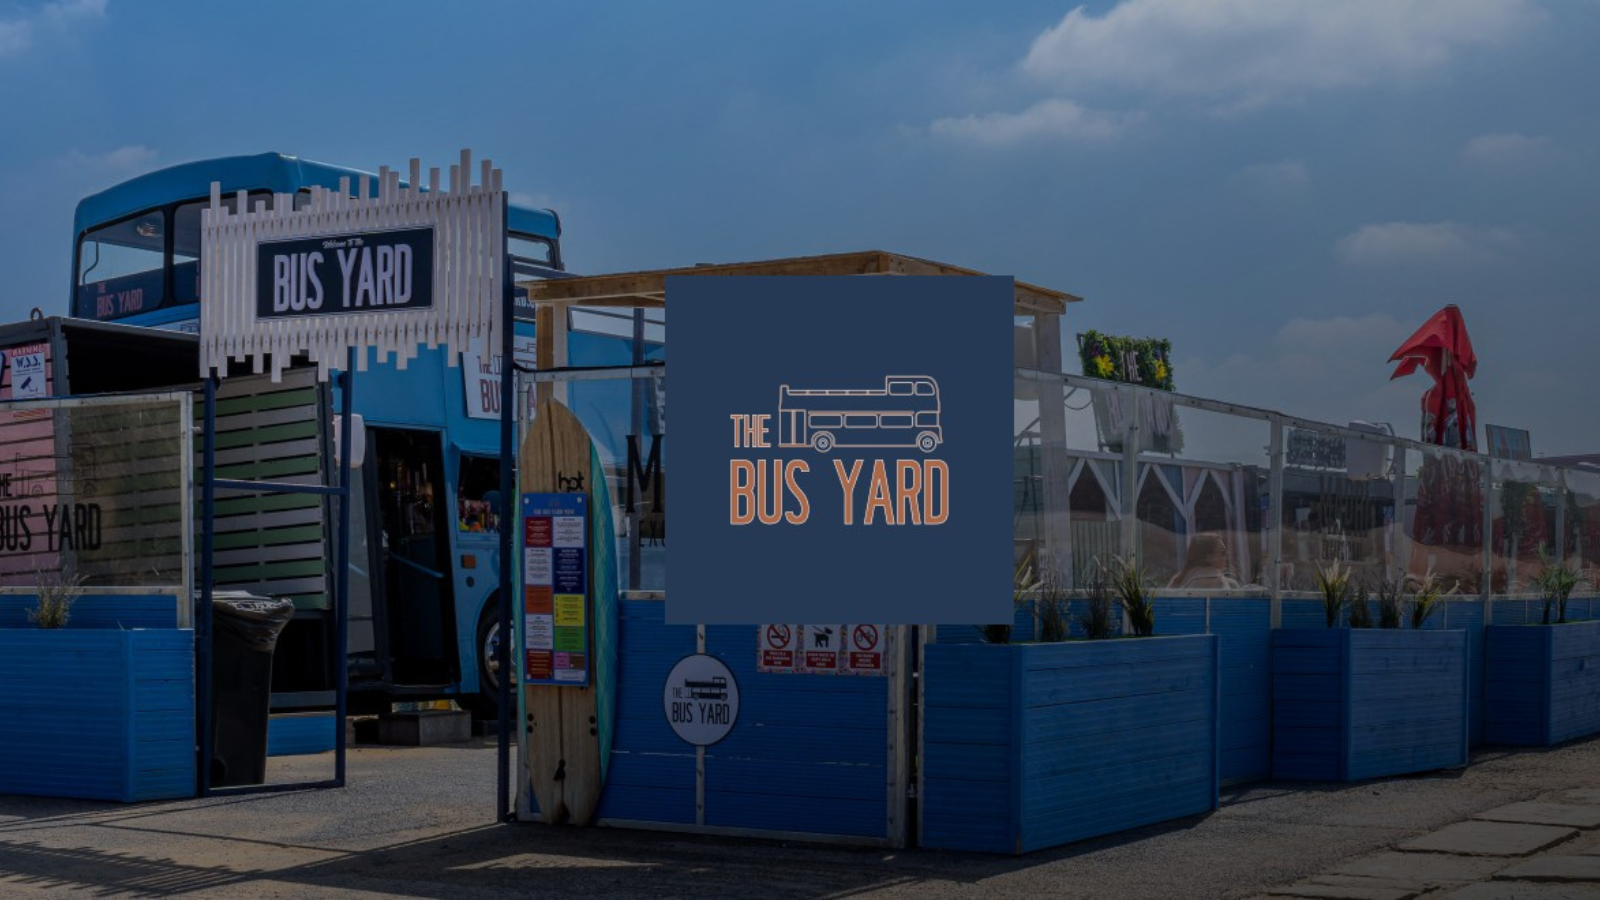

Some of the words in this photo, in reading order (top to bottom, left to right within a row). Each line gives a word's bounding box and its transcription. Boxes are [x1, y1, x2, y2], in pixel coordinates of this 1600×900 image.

[273, 251, 324, 313] BUS
[336, 244, 413, 308] YARD
[97, 294, 114, 317] BUS
[118, 288, 143, 314] YARD
[479, 378, 501, 414] BU
[0, 473, 12, 497] HE
[43, 503, 102, 552] YARD
[673, 687, 682, 698] THE
[672, 702, 693, 723] BUS
[699, 702, 730, 724] YARD
